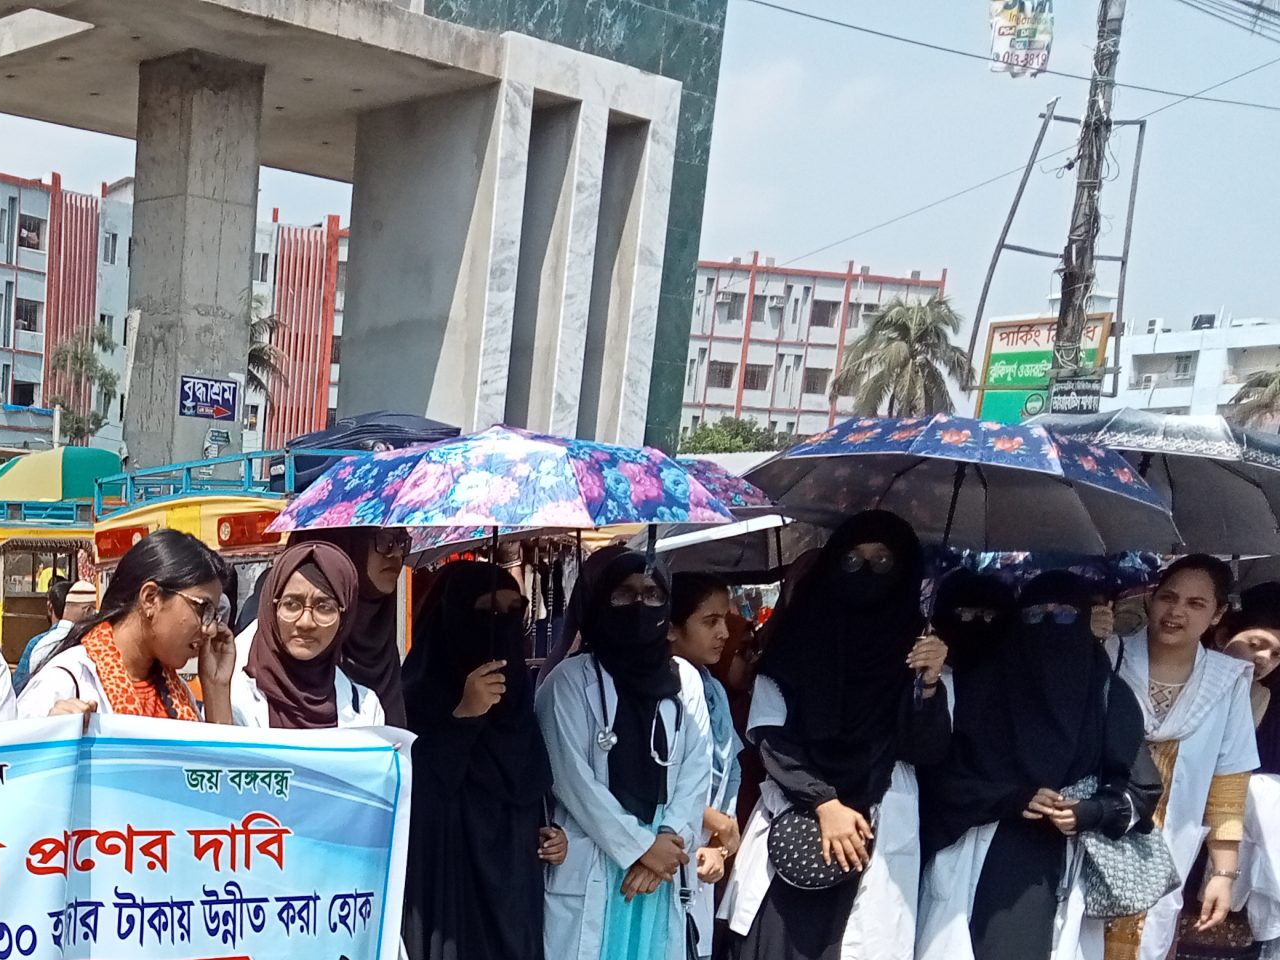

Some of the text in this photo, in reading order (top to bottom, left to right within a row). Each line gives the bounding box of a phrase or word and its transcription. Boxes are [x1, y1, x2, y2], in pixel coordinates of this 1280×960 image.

[182, 377, 236, 405] বৃদ্ধাশ্রম
[184, 768, 292, 798] জয় বঙ্গবন্ধু
[191, 813, 291, 873] দাবি
[114, 887, 194, 944] টাকায়
[201, 881, 265, 951] উন্নীত
[275, 889, 317, 935] করা
[328, 889, 374, 940] হোক
